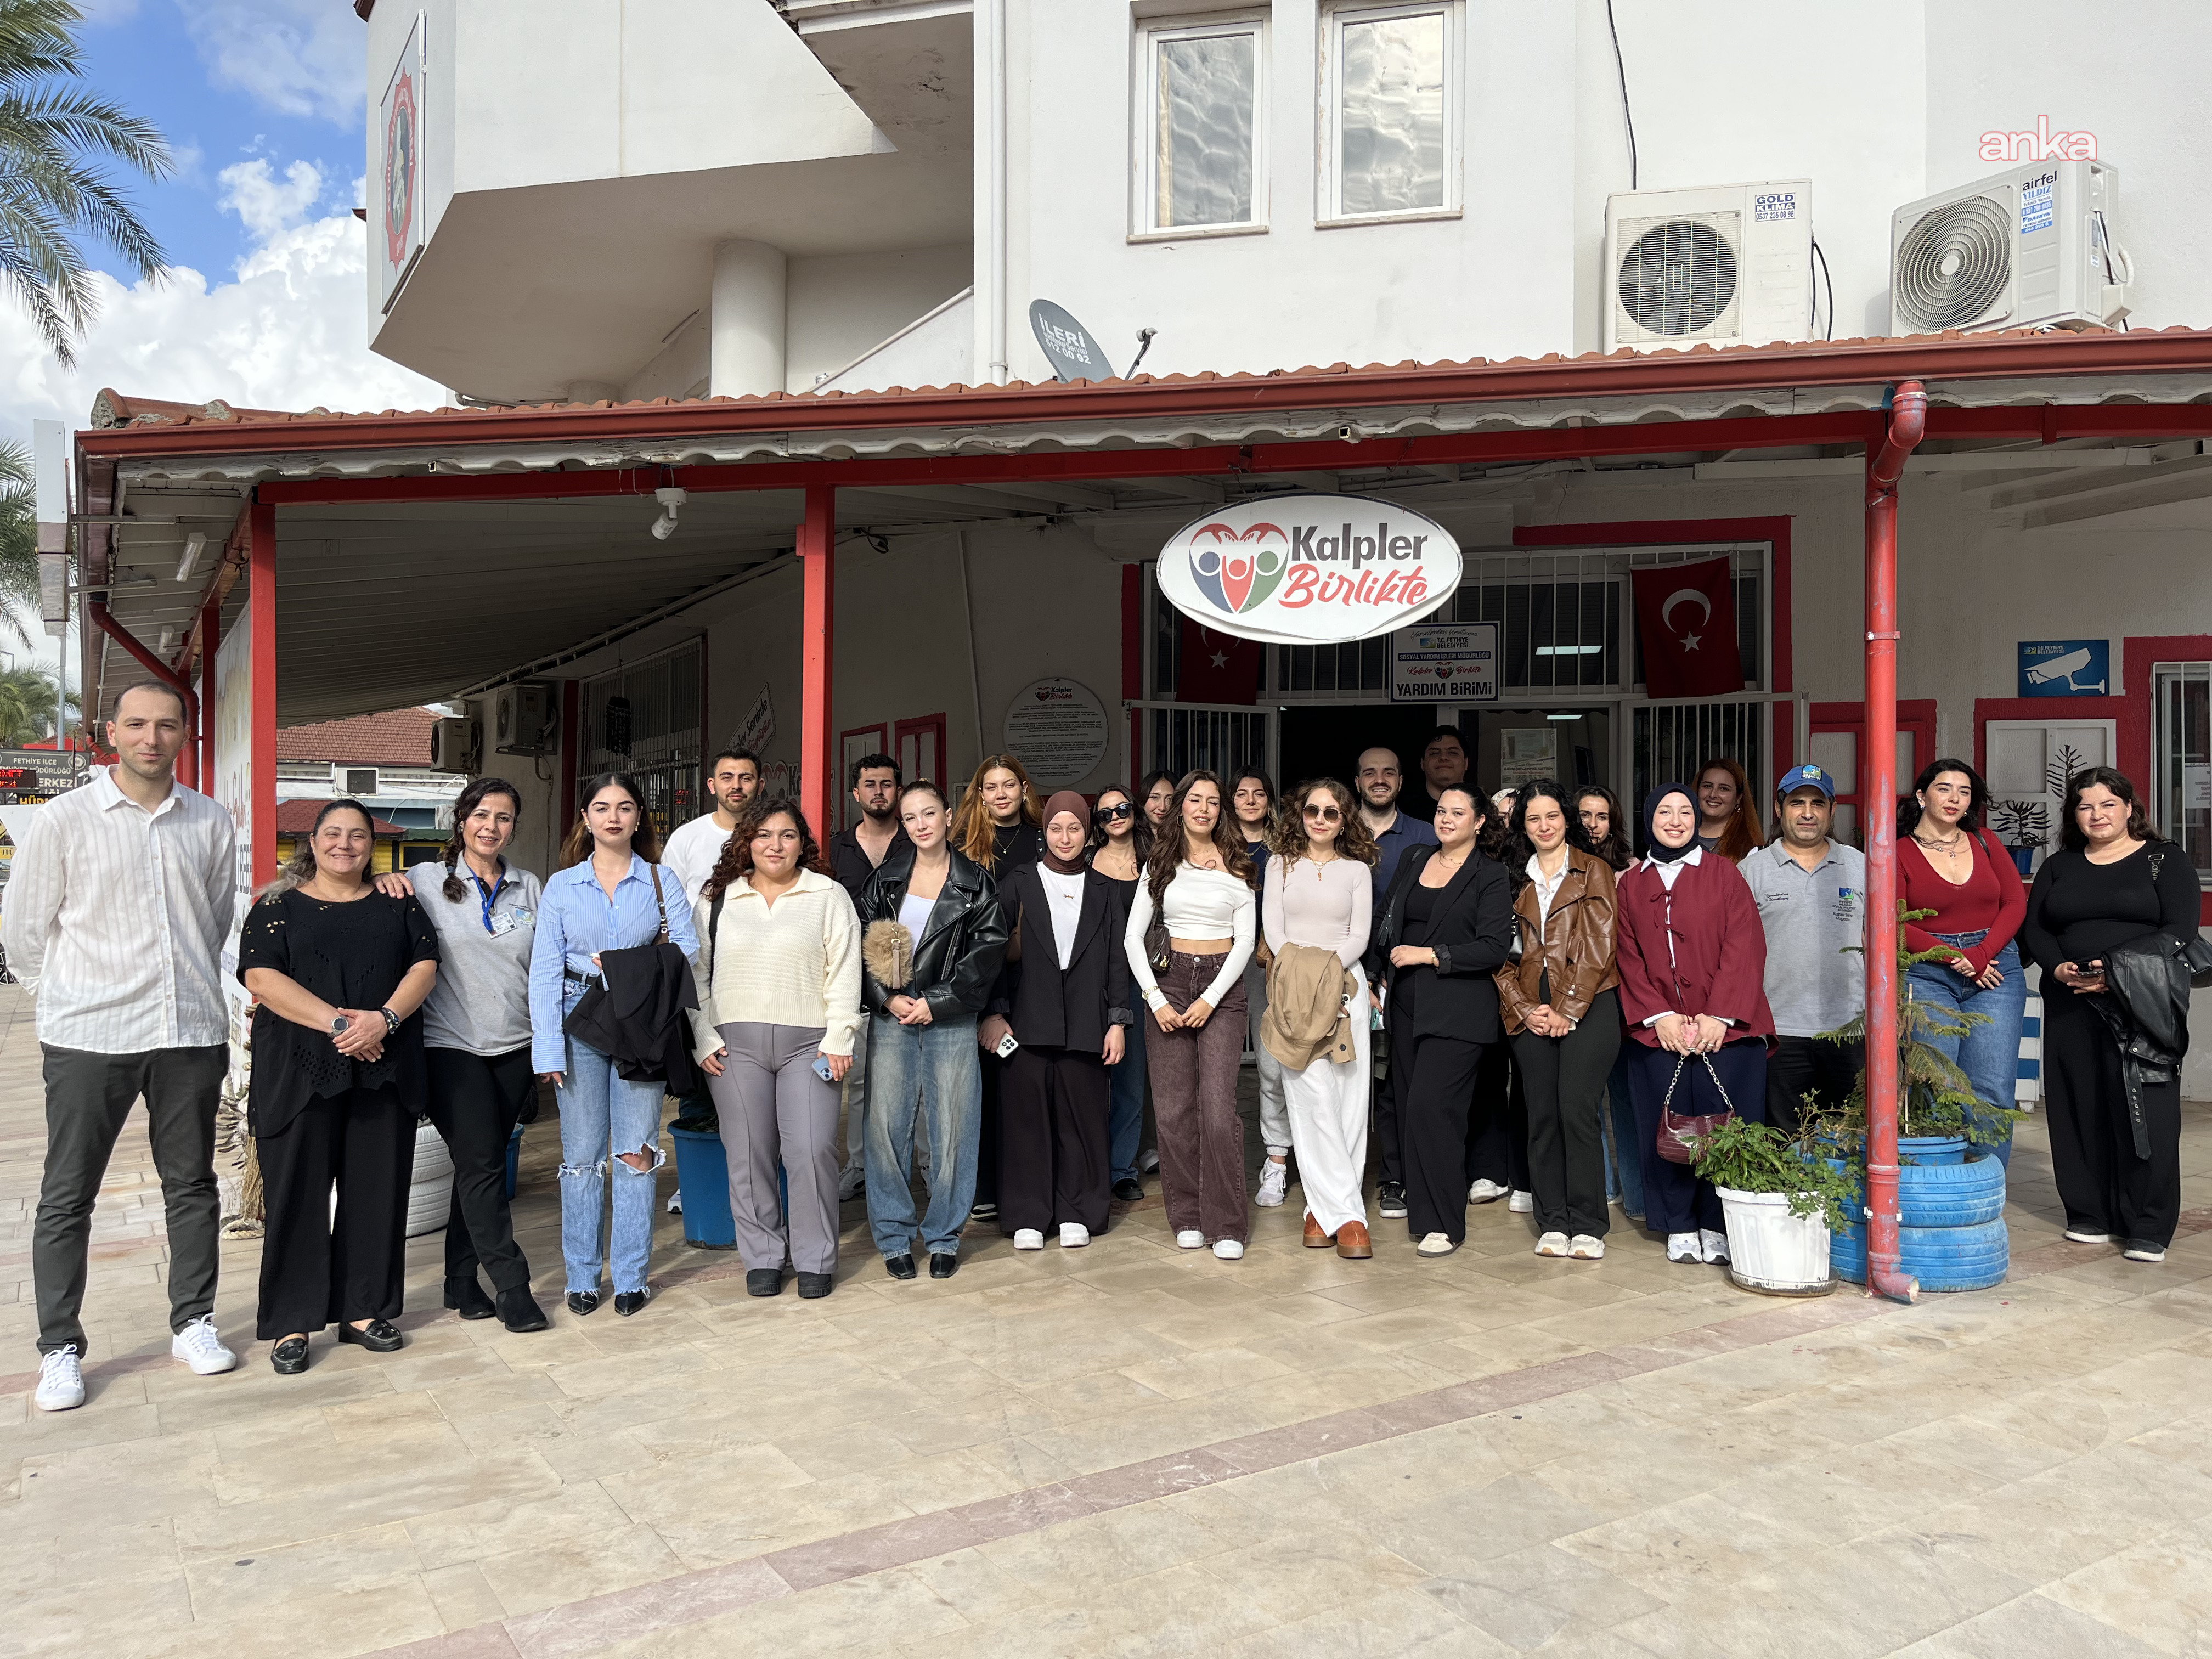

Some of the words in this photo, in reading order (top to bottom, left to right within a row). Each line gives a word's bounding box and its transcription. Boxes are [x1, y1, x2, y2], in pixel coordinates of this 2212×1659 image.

[2023, 171, 2057, 191] airfel
[1757, 195, 1793, 204] GOLD
[2023, 185, 2051, 200] YILDIZ
[2027, 212, 2051, 222] DAIKIN
[1039, 313, 1086, 348] İLERİ
[1076, 353, 1091, 364] 92
[1291, 523, 1428, 569] Kalpler
[1278, 563, 1427, 608] Birlikte
[1407, 666, 1433, 675] Kalpler
[1456, 665, 1482, 675] Birlikte
[1396, 682, 1446, 696] YARDIM
[747, 698, 767, 736] Seninle
[43, 758, 57, 766] İLÇE
[39, 777, 77, 788] ERKEZİ
